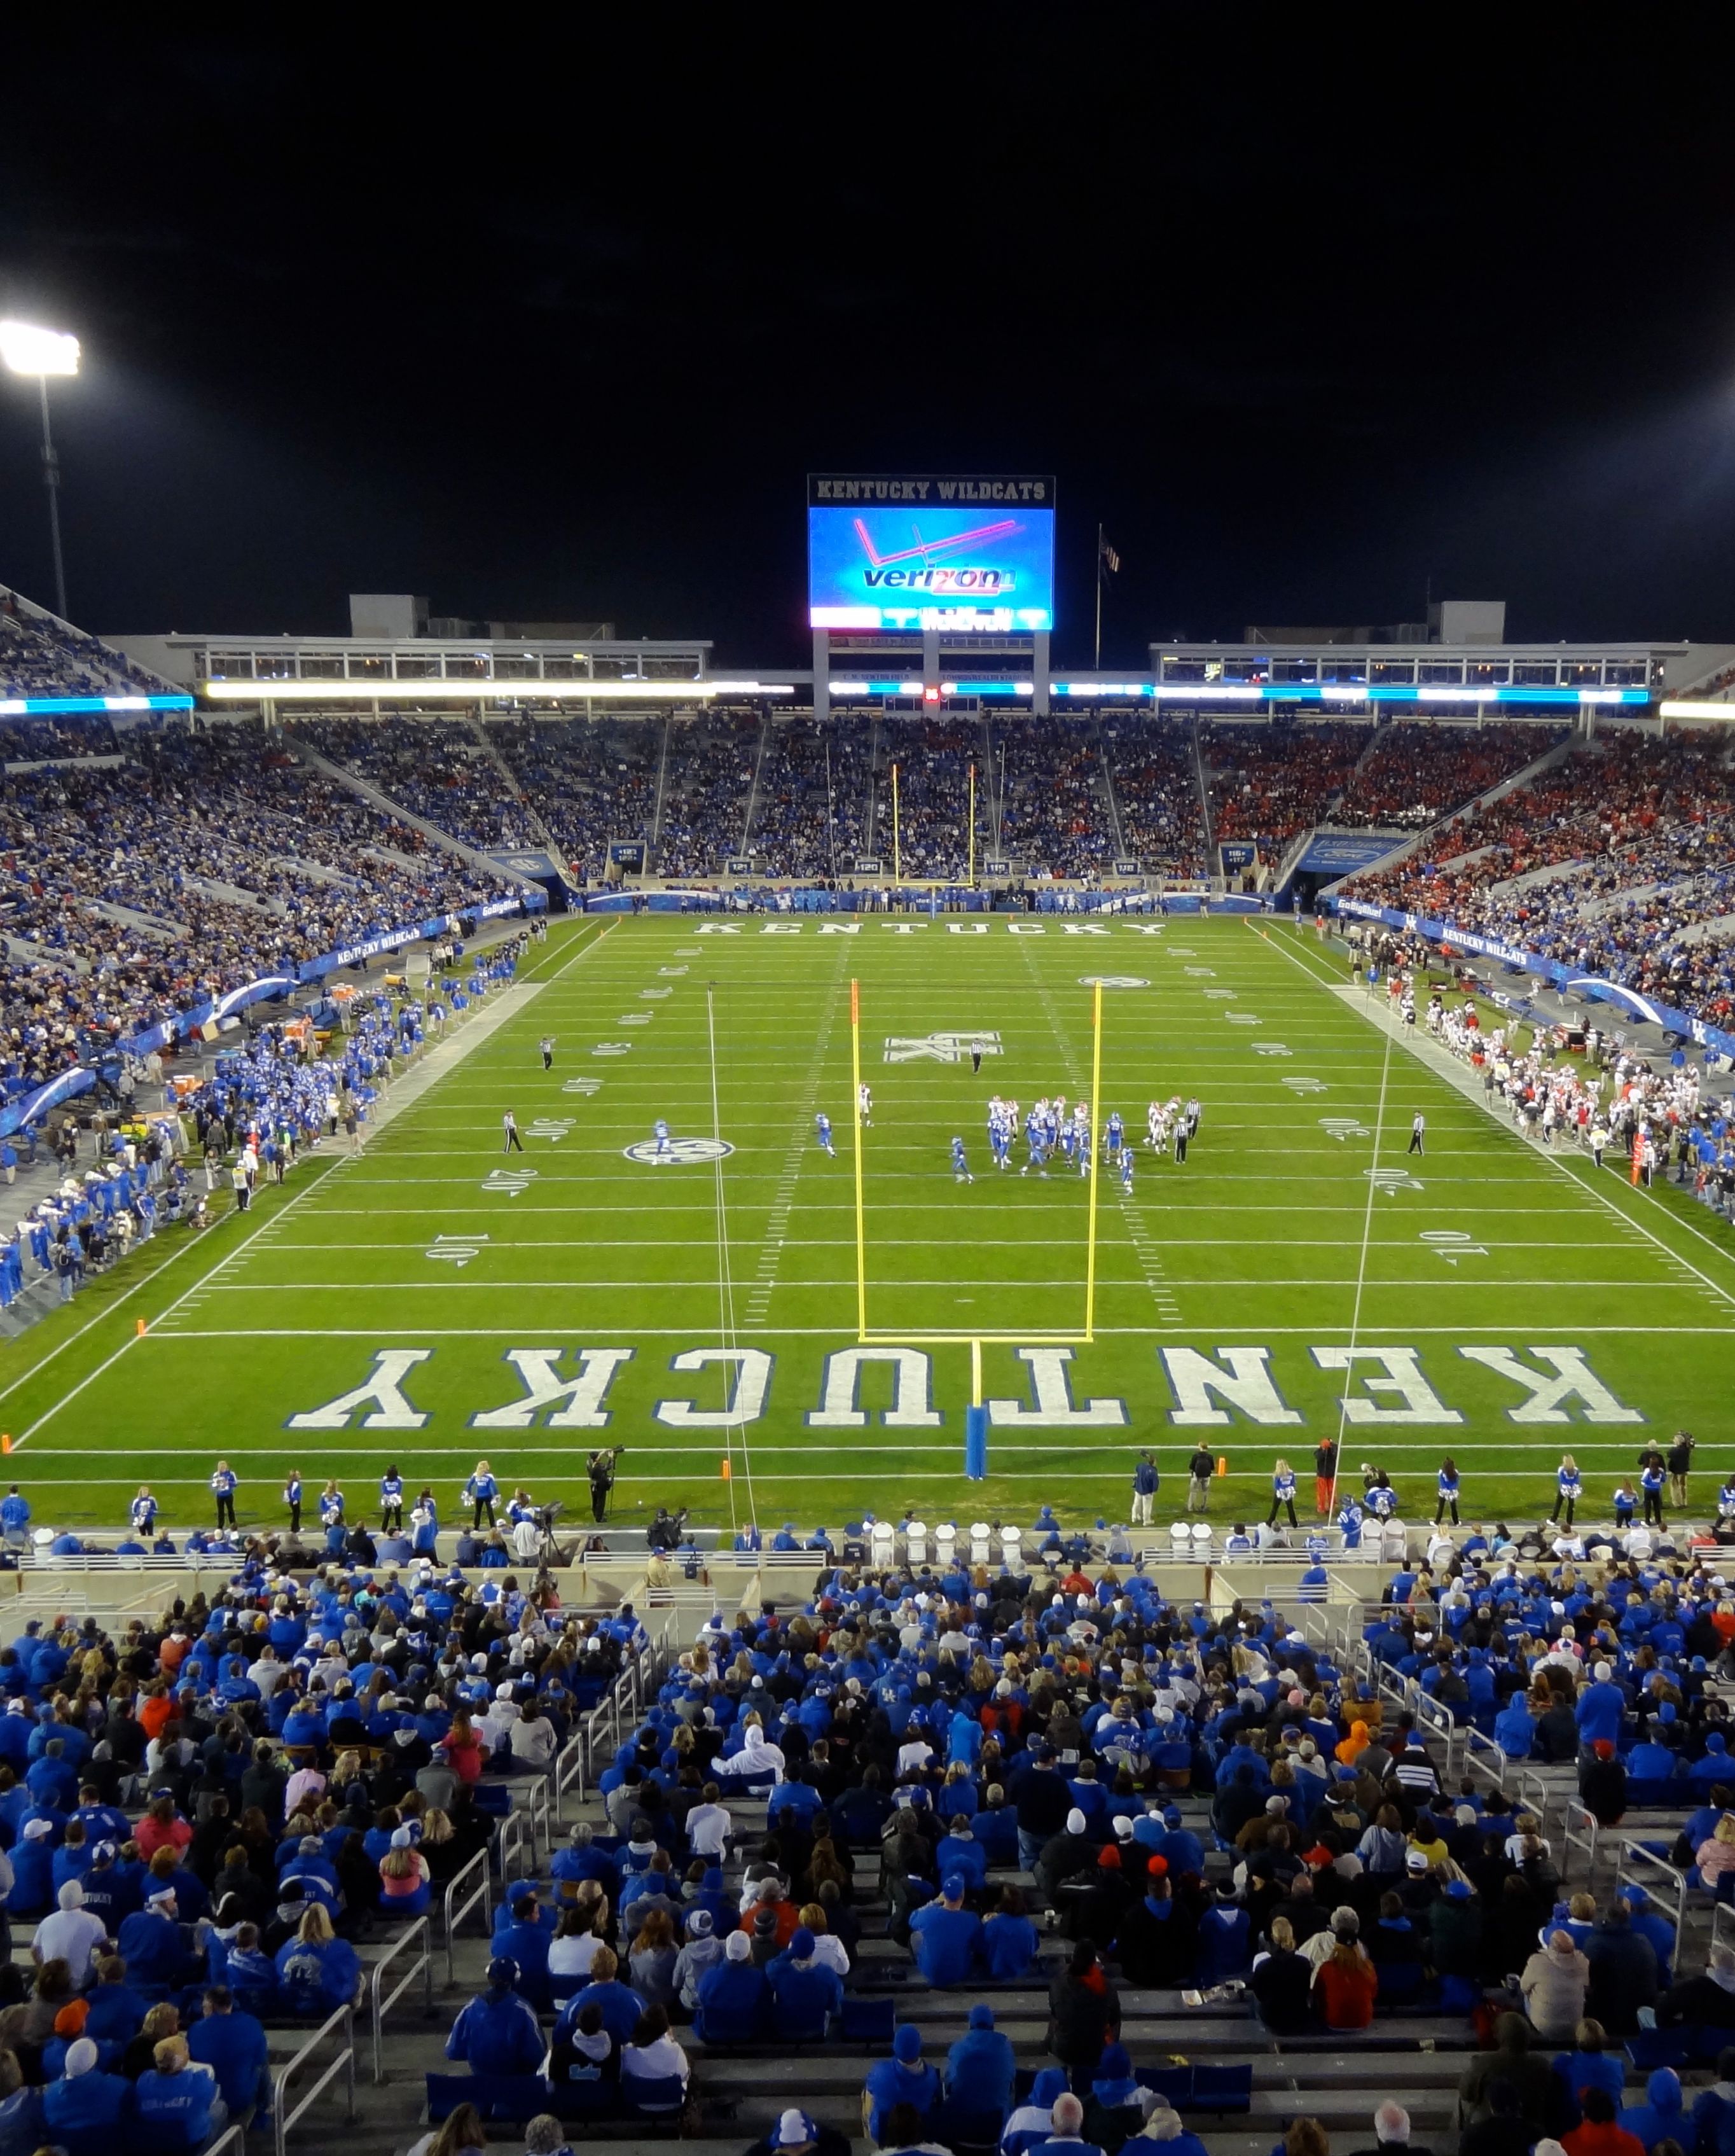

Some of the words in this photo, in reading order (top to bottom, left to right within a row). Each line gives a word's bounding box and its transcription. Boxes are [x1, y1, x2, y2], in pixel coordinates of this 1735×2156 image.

[817, 481, 929, 499] KENTUCKY
[937, 482, 1045, 499] WILDCATS
[863, 564, 1009, 594] verizon
[693, 922, 1166, 935] KENTUCKY
[1442, 928, 1484, 952] KENTUCKY
[481, 1169, 539, 1191] 20
[1362, 1169, 1425, 1190] 20
[425, 1233, 491, 1260] 10
[1418, 1230, 1490, 1256] 10
[284, 1346, 1647, 1428] KENTUCKY
